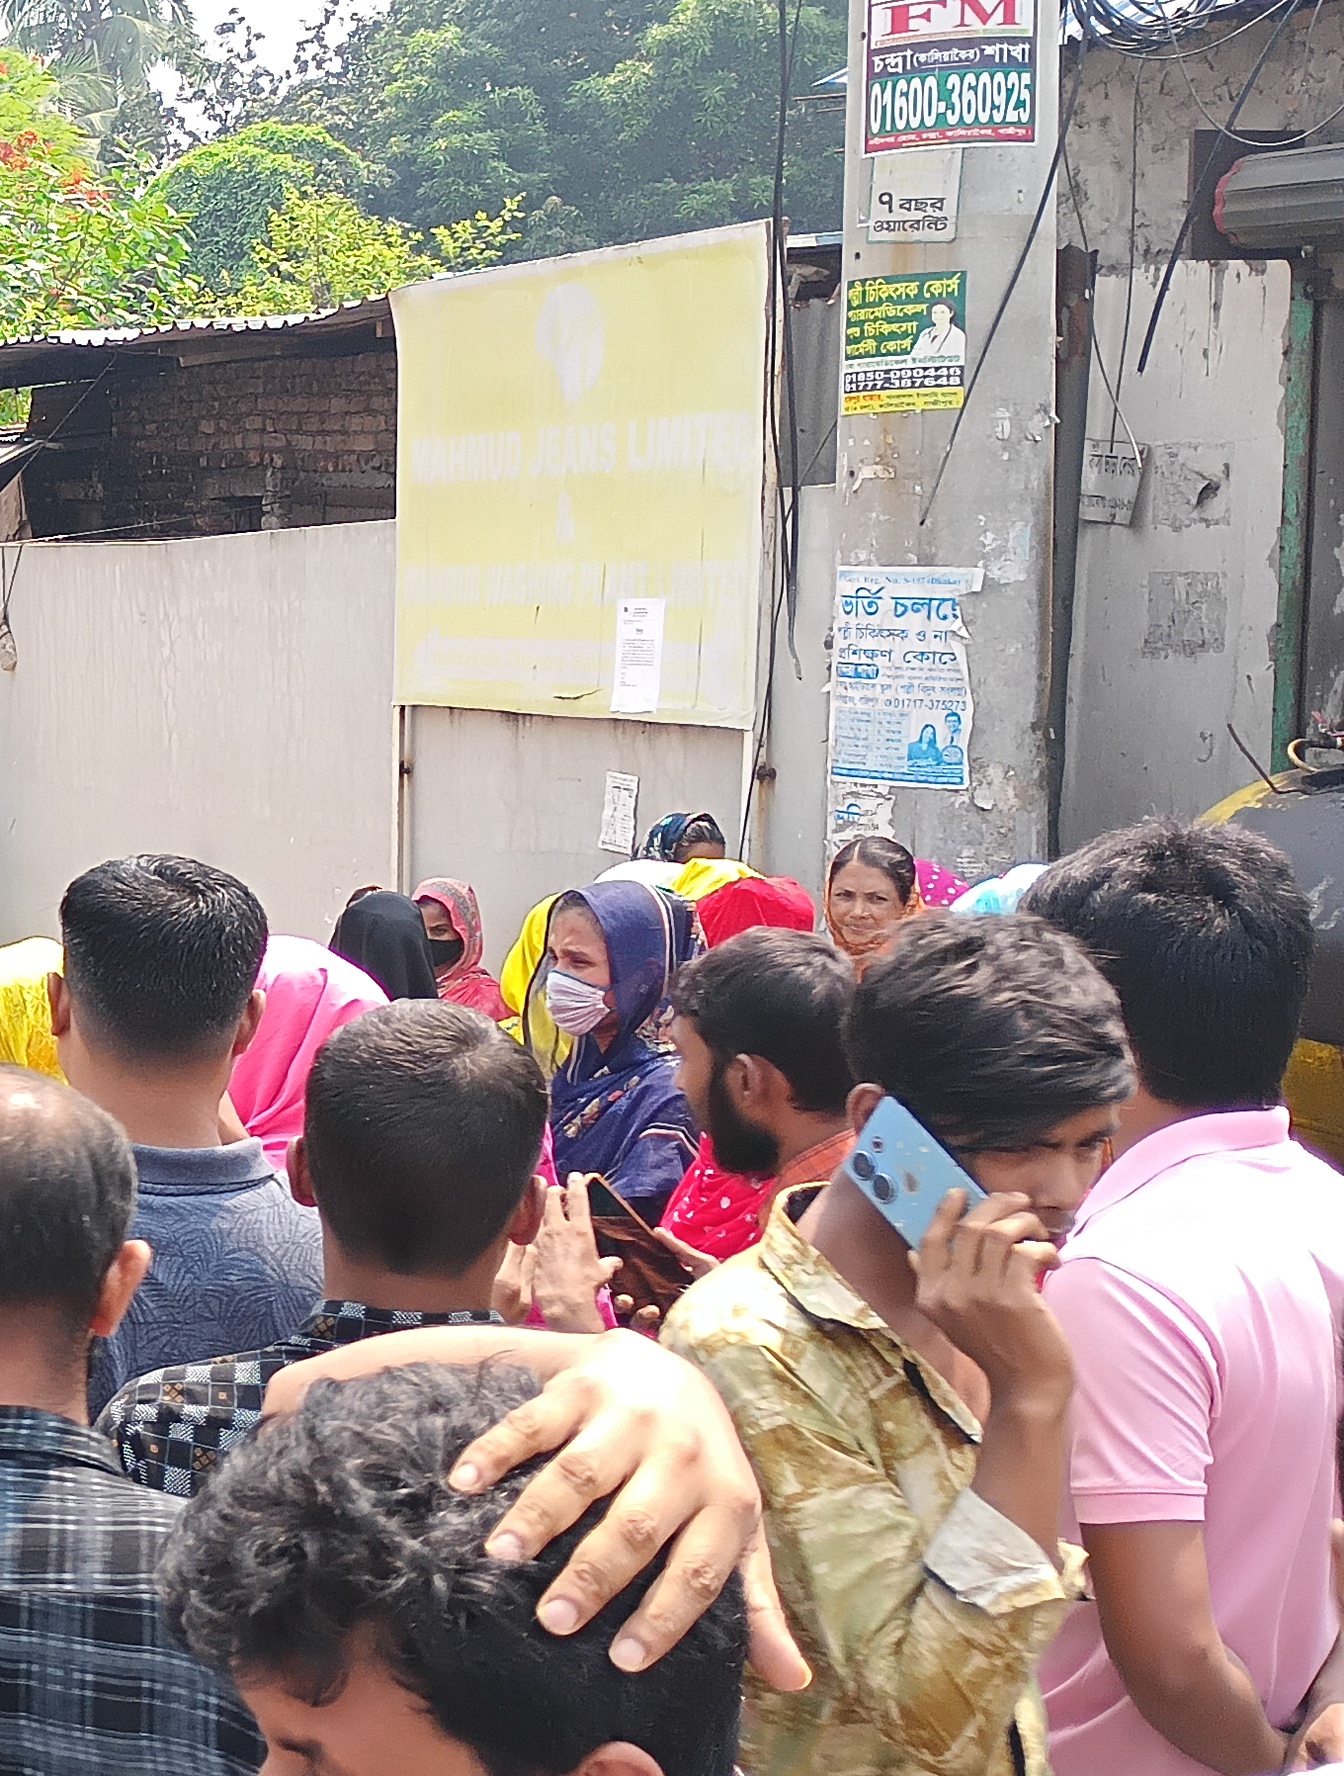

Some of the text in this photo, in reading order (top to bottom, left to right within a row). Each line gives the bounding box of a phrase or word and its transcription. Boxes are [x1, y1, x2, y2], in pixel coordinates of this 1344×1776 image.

[872, 49, 913, 73] চন্দ্রা
[981, 43, 1030, 63] শাখা
[870, 71, 1031, 134] 01600-360925
[899, 197, 947, 213] বছর
[873, 215, 949, 233] ওয়ারেন্টি
[865, 279, 919, 303] চিকিৎসক
[923, 273, 961, 298] কোর্স
[530, 420, 617, 477] JEANS
[841, 586, 885, 618] ভর্তি
[916, 630, 926, 641] ও
[839, 643, 893, 662] প্রশিক্ষণ
